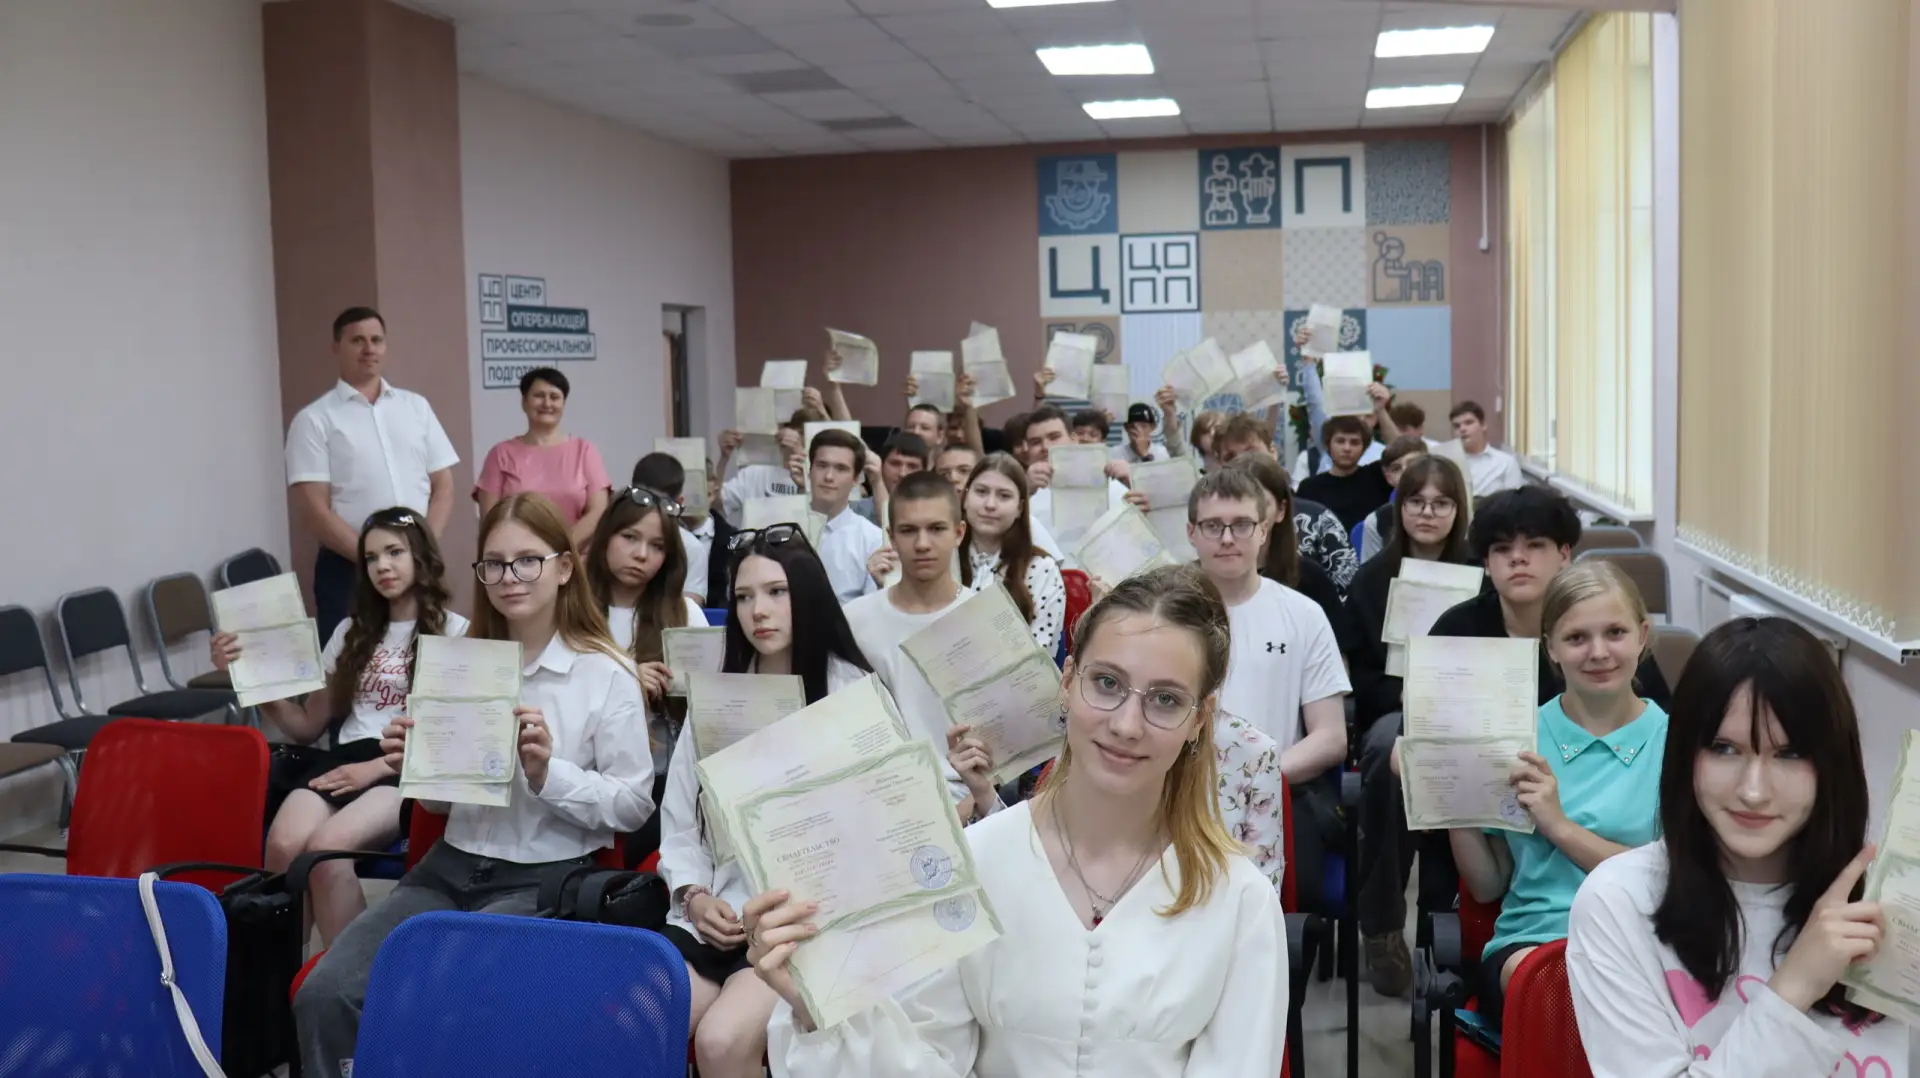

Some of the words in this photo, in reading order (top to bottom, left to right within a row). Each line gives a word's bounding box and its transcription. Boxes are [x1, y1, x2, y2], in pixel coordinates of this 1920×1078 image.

[1294, 156, 1352, 215] П
[1048, 245, 1111, 304] Ц
[510, 283, 542, 299] ЦЕНТР
[511, 311, 587, 330] ОПЕРЕЖАЮЩЕЙ
[486, 337, 592, 354] ПРОФЕССИОНАЛЬНОЙ
